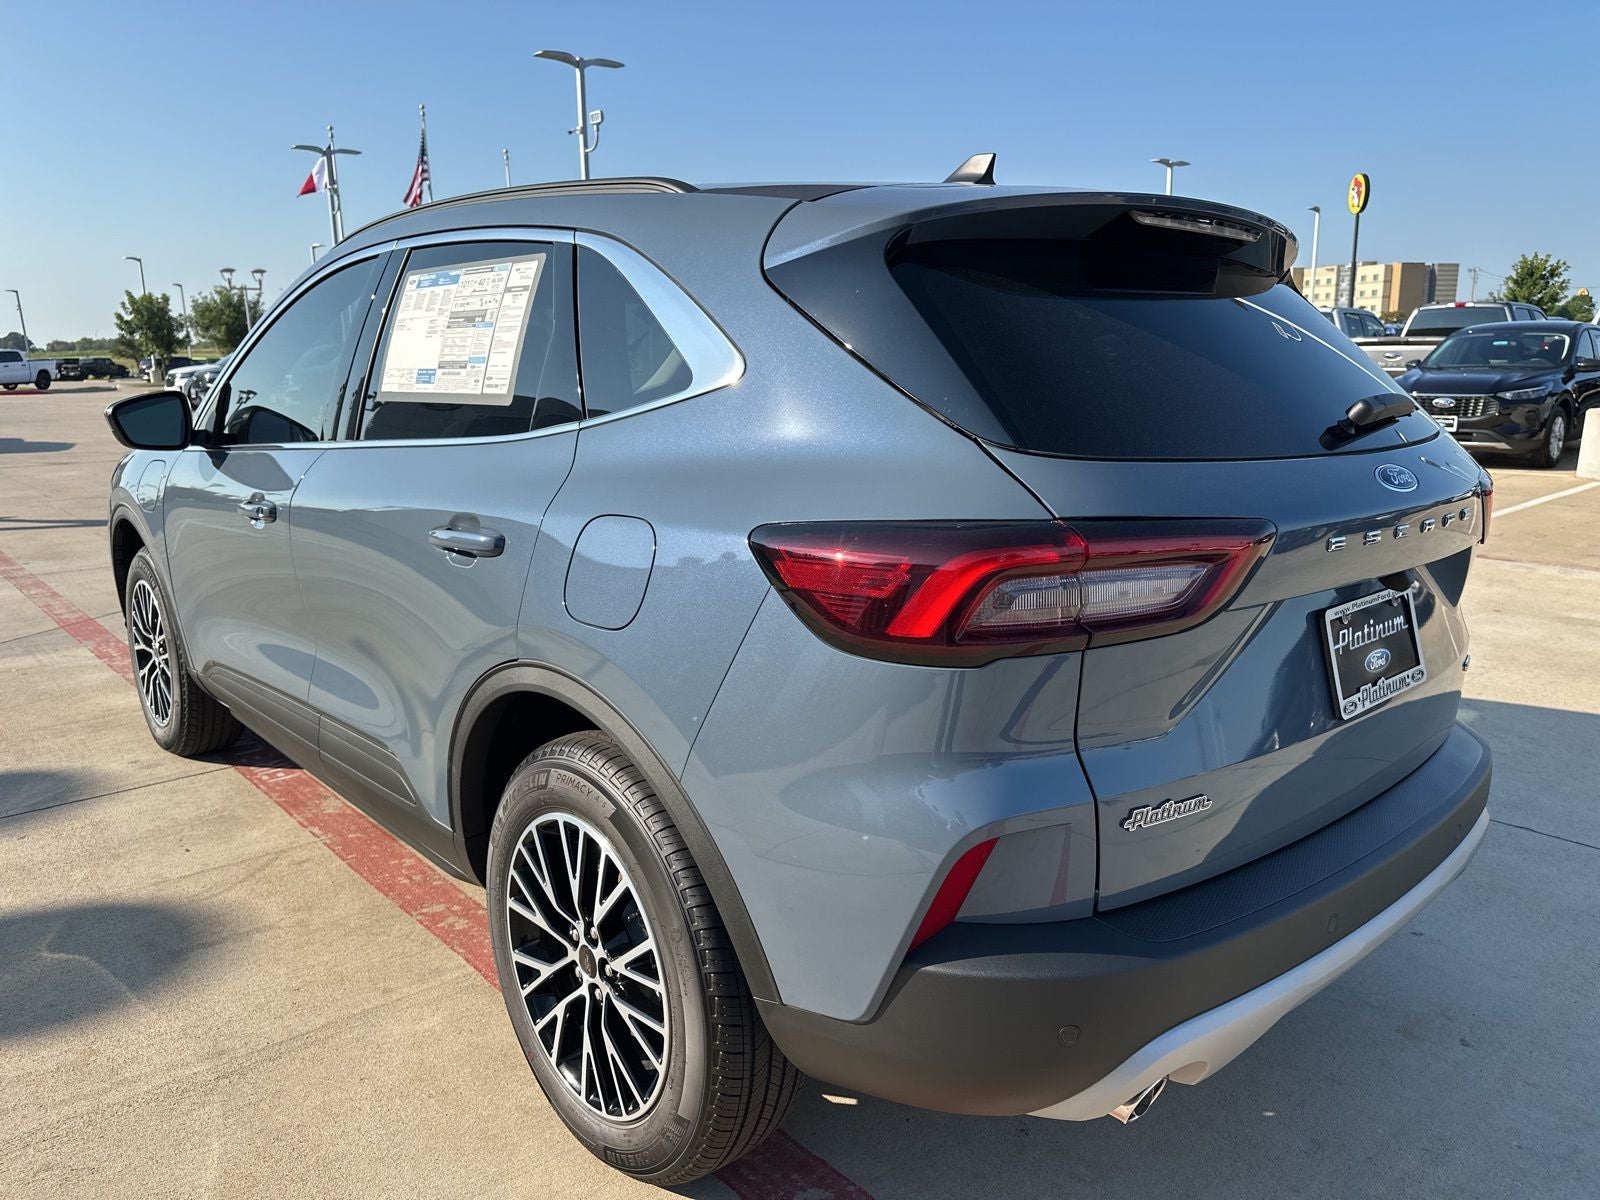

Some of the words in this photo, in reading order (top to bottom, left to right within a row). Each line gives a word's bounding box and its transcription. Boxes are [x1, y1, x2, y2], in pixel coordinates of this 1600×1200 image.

[1325, 507, 1470, 552] ESCAPE
[1333, 614, 1409, 655] Platinum
[1359, 672, 1410, 709] Platinum
[556, 773, 592, 797] PRIMACY
[1123, 795, 1213, 832] Platinum
